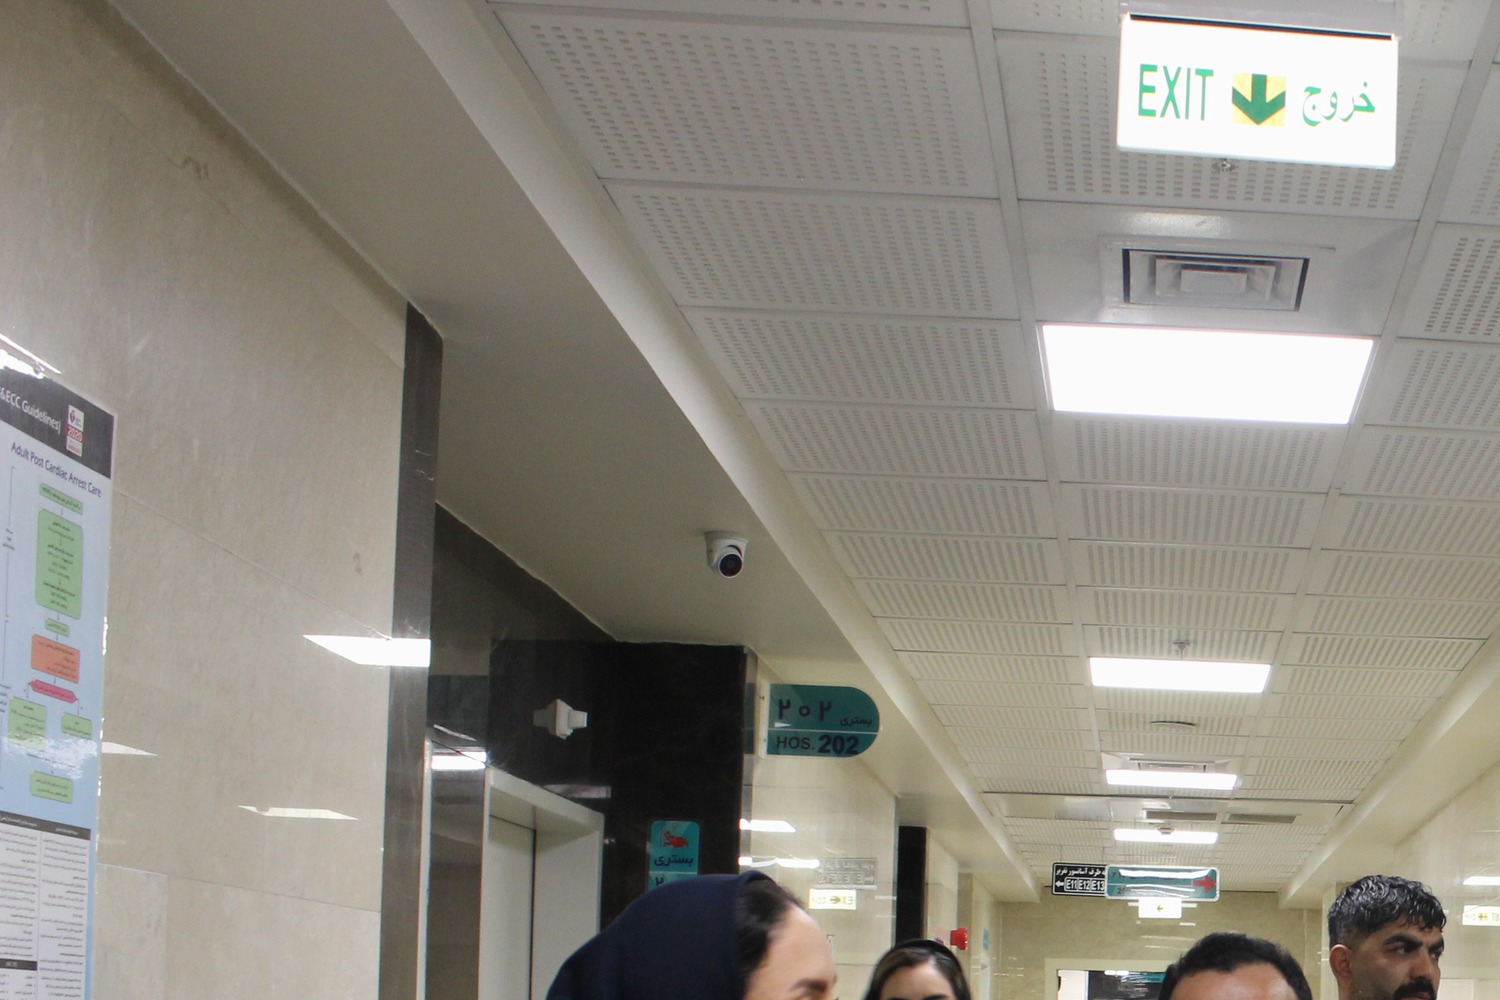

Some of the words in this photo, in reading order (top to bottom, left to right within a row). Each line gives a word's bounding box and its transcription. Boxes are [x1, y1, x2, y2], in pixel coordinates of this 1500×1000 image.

[1138, 64, 1213, 120] EXIT
[1302, 80, 1375, 127] خروج
[0, 386, 20, 408] &ECC
[11, 442, 29, 461] Adult
[30, 452, 44, 468] Post
[45, 459, 68, 480] Cardiac
[68, 473, 87, 491] Arrest
[88, 482, 102, 498] Care
[840, 715, 873, 727] بستری
[776, 736, 814, 750] HOS.
[818, 735, 859, 754] 202
[654, 853, 693, 867] بستری
[1066, 879, 1077, 889] E11
[1078, 880, 1090, 889] E12
[1091, 880, 1105, 890] E13
